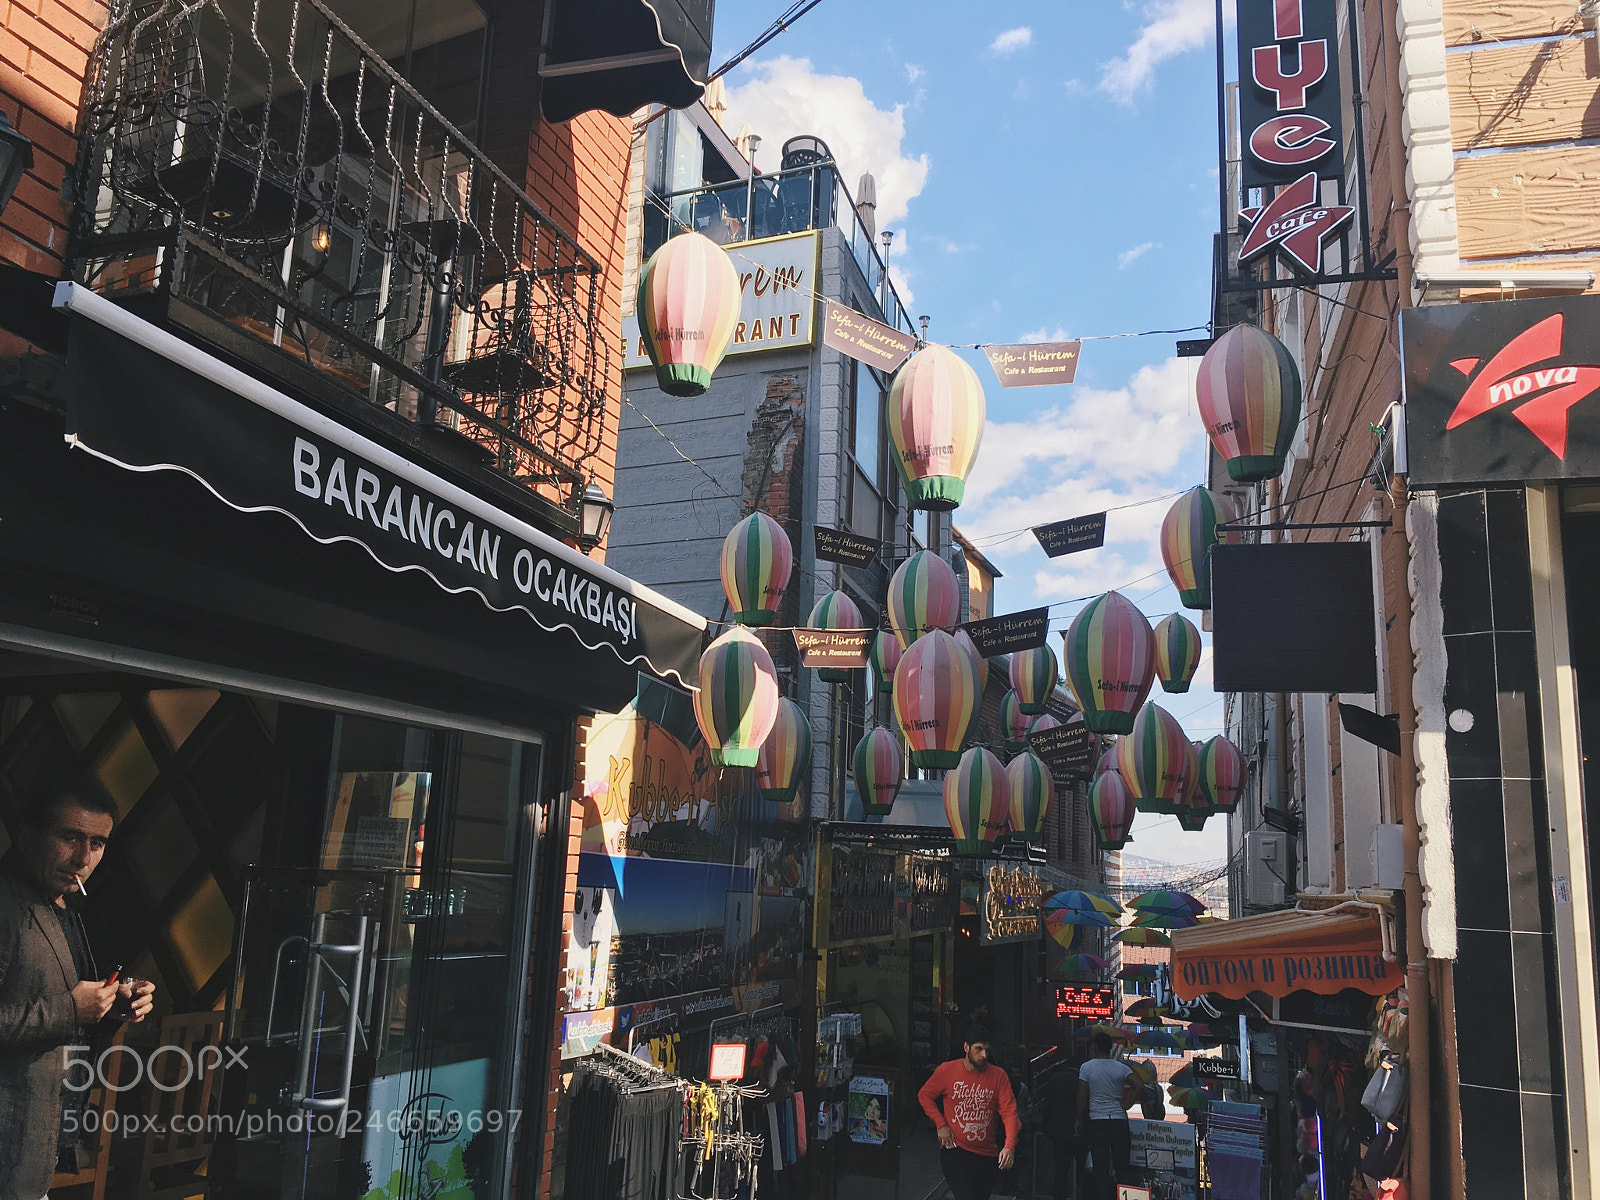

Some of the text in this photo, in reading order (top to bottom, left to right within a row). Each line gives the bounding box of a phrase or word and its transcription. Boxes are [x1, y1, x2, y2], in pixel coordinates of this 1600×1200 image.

[1489, 366, 1578, 403] nova
[293, 436, 638, 645] BARANCAN OCAKBAŞI
[1262, 958, 1276, 983] и
[951, 1081, 994, 1101] Fitchburg
[951, 1104, 993, 1128] Racing
[966, 1123, 987, 1141] 33
